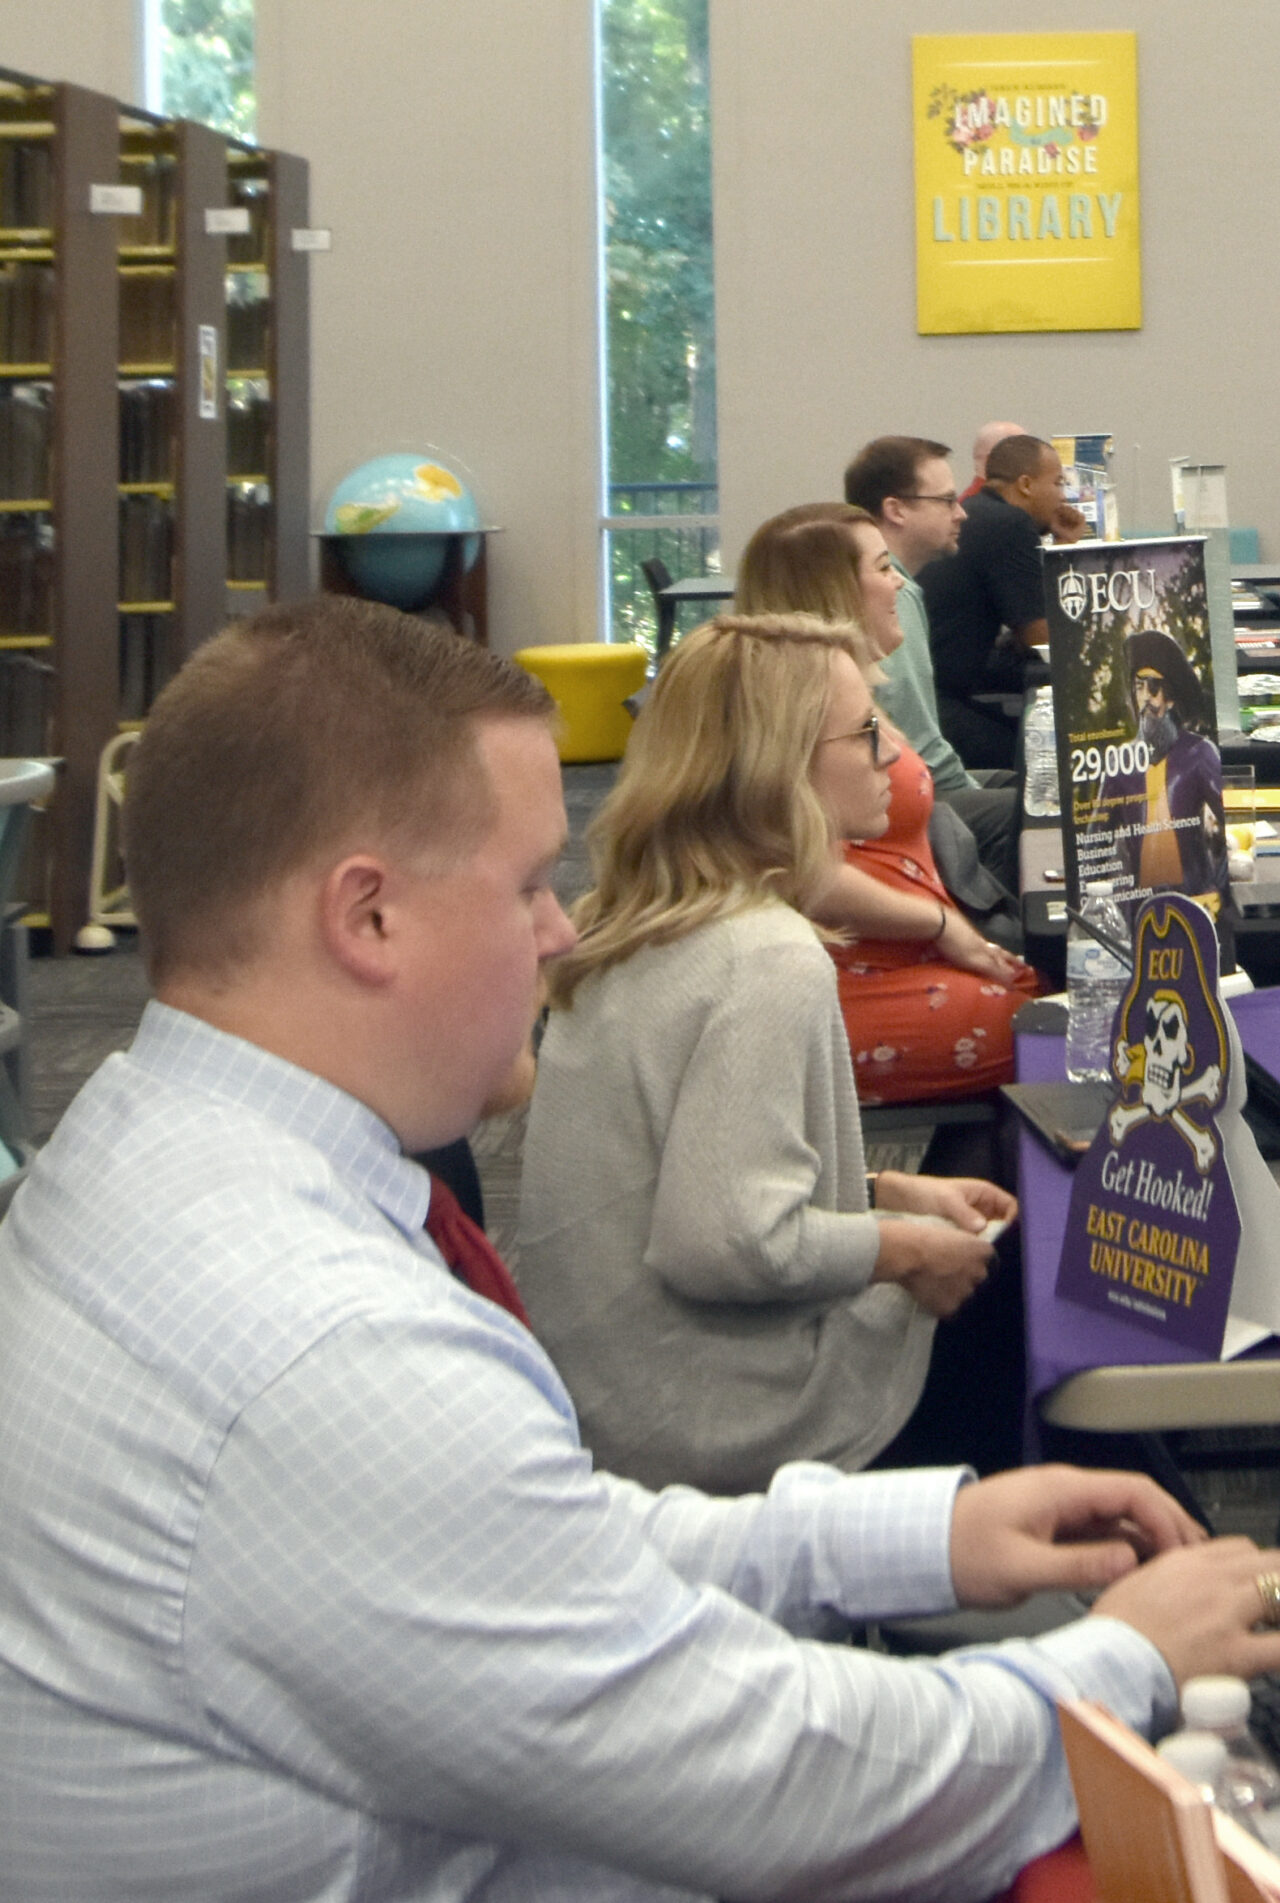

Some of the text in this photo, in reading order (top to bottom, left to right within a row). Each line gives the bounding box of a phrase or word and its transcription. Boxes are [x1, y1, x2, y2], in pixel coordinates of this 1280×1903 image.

[954, 94, 1109, 129] IMAGINED
[963, 146, 1098, 176] PARADISE
[932, 192, 1123, 242] LIBRARY
[1088, 569, 1156, 614] ECU
[1076, 830, 1113, 846] Nursing
[1163, 816, 1201, 832] Sciences
[1077, 845, 1118, 862] Business
[1078, 860, 1123, 877] Education
[1148, 948, 1184, 980] ECU
[1101, 1150, 1214, 1223] Get Hooked!
[1087, 1203, 1209, 1276] EAST CAROLINA
[1089, 1239, 1198, 1309] UNIVERSITY
